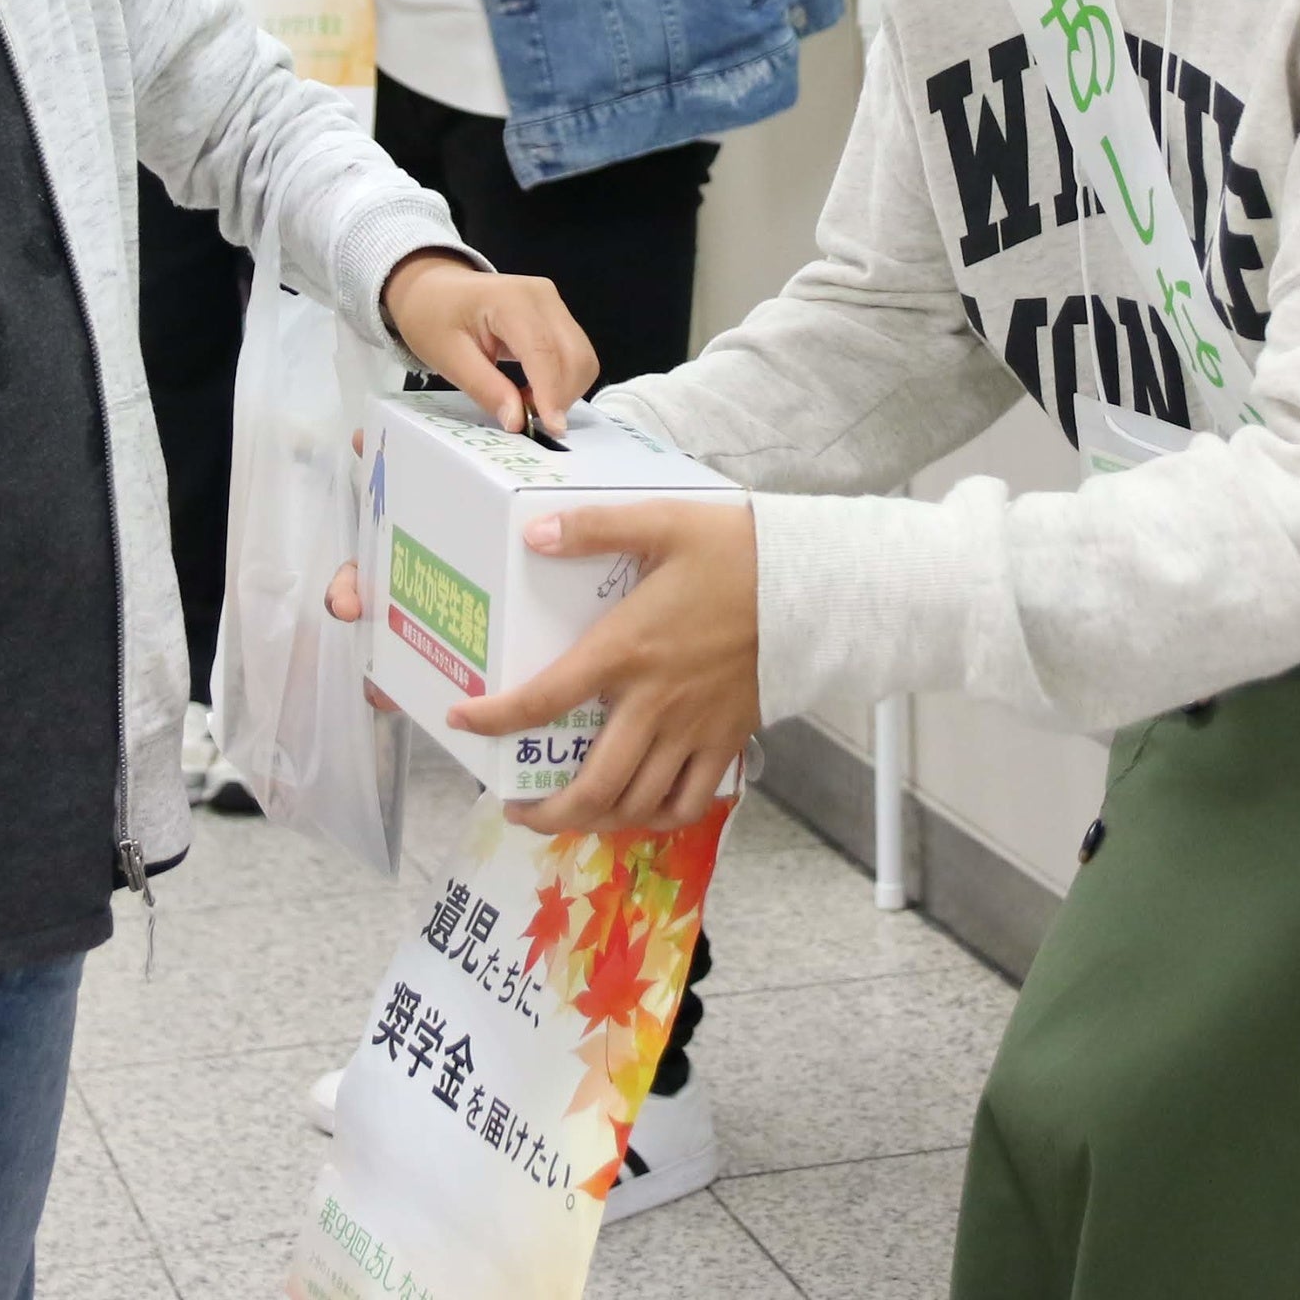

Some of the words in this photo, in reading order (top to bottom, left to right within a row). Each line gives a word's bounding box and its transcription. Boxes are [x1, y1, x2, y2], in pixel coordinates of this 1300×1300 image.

[392, 540, 488, 661] あしなが学生募金
[421, 876, 542, 1029] 遺児たちに、
[371, 981, 576, 1212] 奨学金を届けたい。
